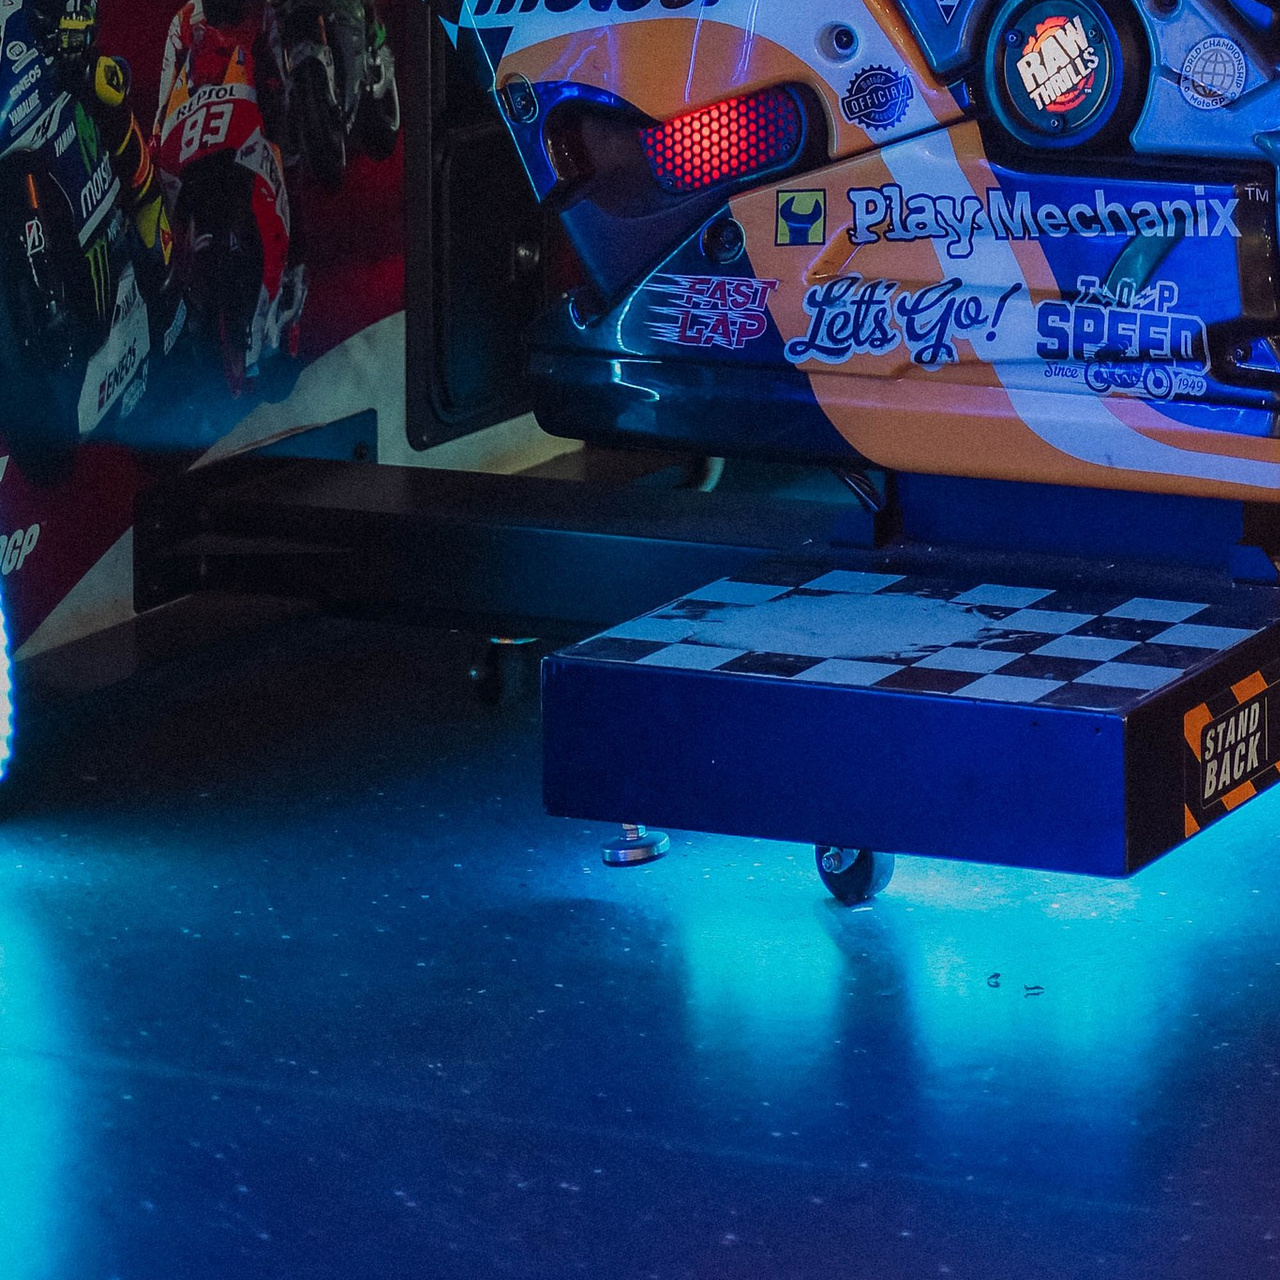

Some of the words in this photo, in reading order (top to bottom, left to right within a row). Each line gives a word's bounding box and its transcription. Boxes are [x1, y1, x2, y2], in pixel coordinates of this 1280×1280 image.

[1016, 15, 1089, 93] RAW
[1029, 47, 1100, 111] THRILLS
[1182, 47, 1202, 82] WORLD
[1203, 39, 1244, 89] CHAMPIONSHIP
[1189, 94, 1226, 108] MotoGP
[848, 184, 985, 259] Play
[987, 185, 1243, 240] Mechanix
[682, 277, 779, 312] FAST
[786, 275, 899, 358] Let's
[899, 277, 1023, 366] Go!
[1077, 275, 1179, 313] TOP
[677, 310, 769, 348] LAP
[1036, 301, 1211, 368] SPEED
[1044, 361, 1080, 379] Since
[1177, 377, 1204, 392] 1949
[1204, 702, 1261, 760] STAND
[1203, 739, 1261, 799] BACK
